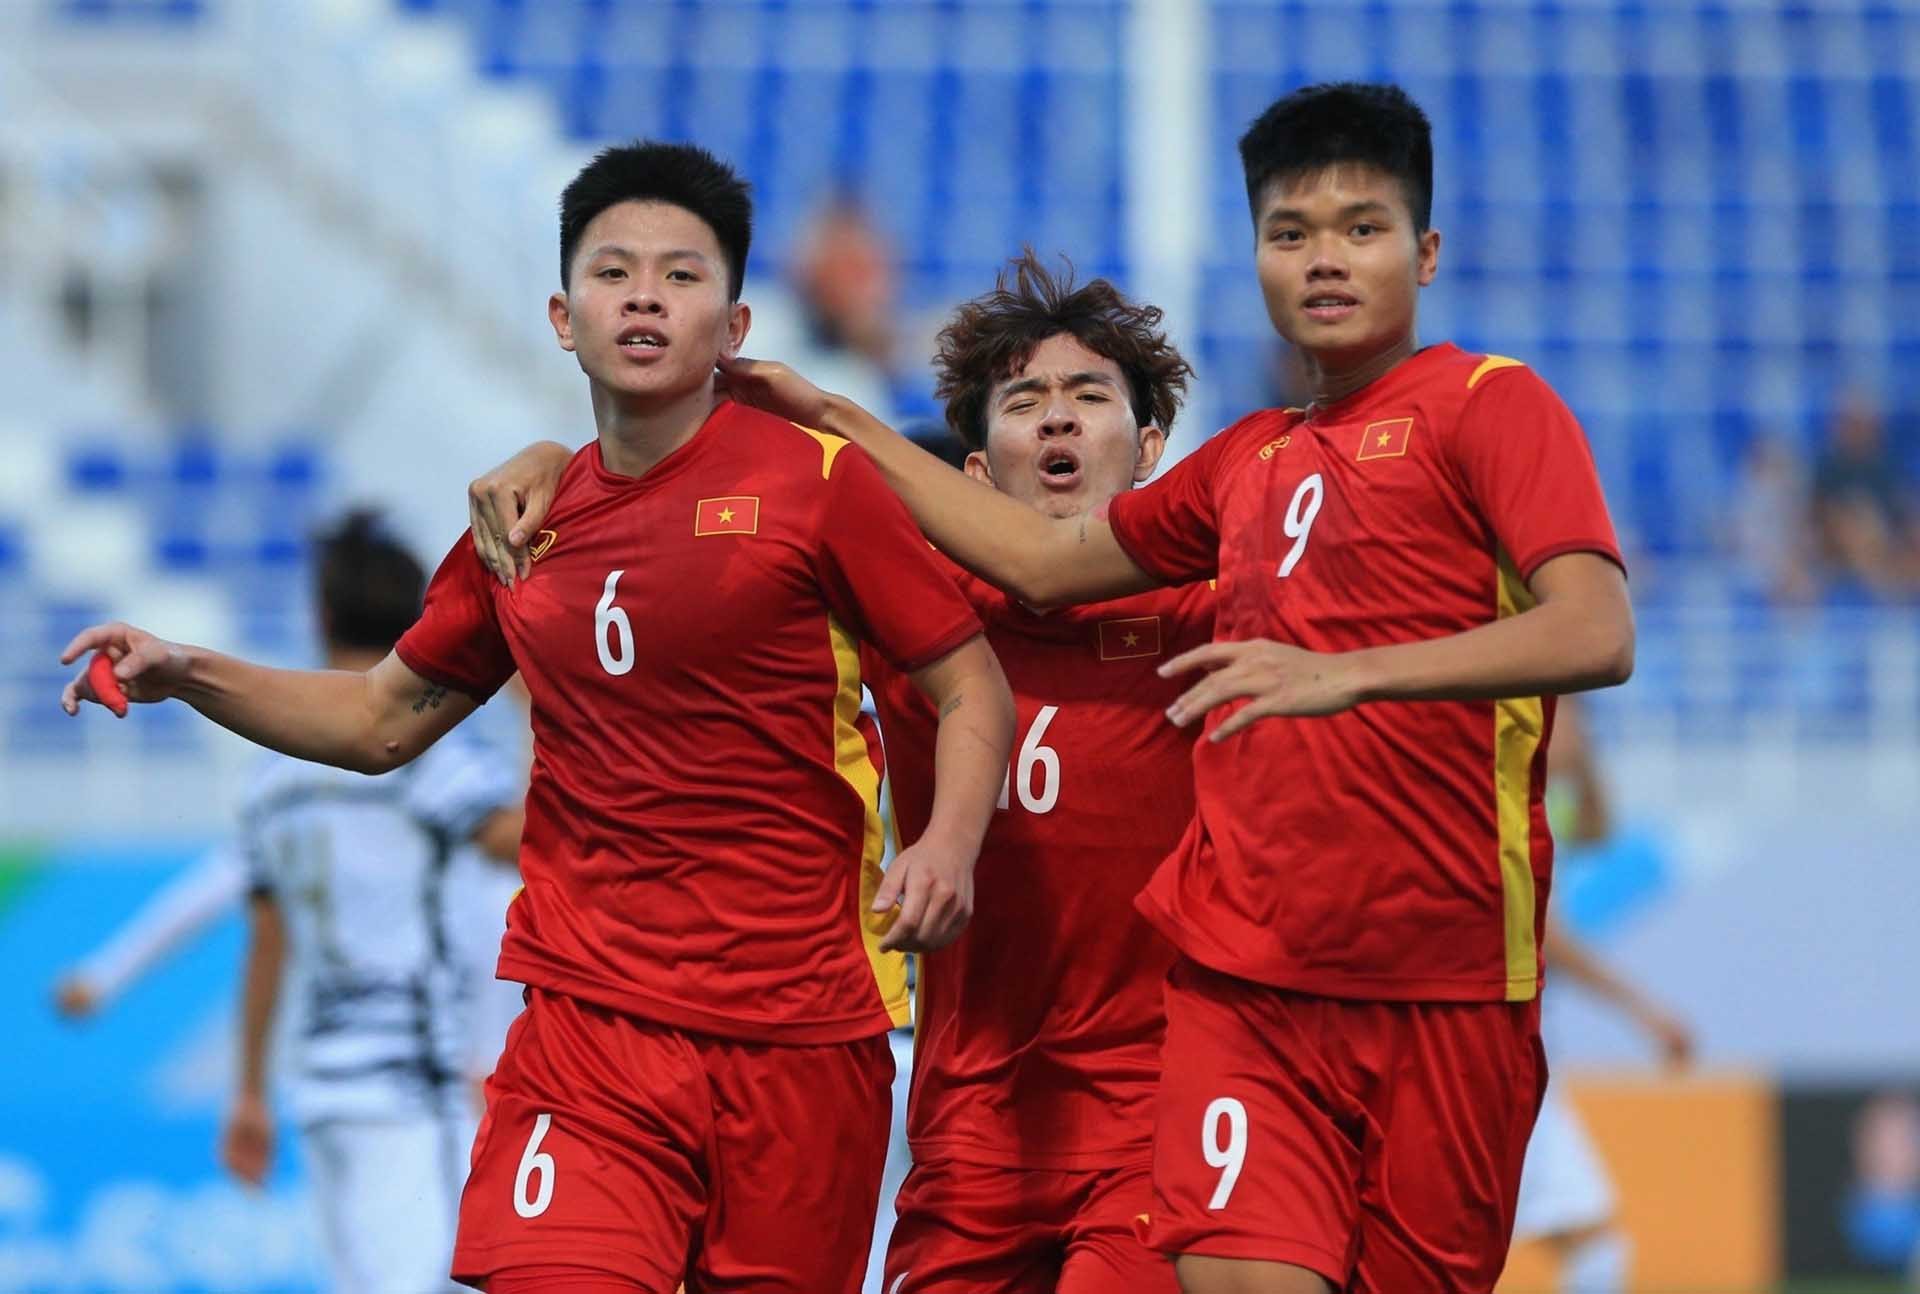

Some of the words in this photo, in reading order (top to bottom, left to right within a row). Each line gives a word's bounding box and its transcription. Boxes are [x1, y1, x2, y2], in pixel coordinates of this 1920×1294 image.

[1277, 473, 1324, 578] 9
[594, 569, 635, 676] 6
[996, 705, 1060, 814] 6
[513, 1113, 556, 1219] 6
[1202, 1096, 1248, 1210] 9
